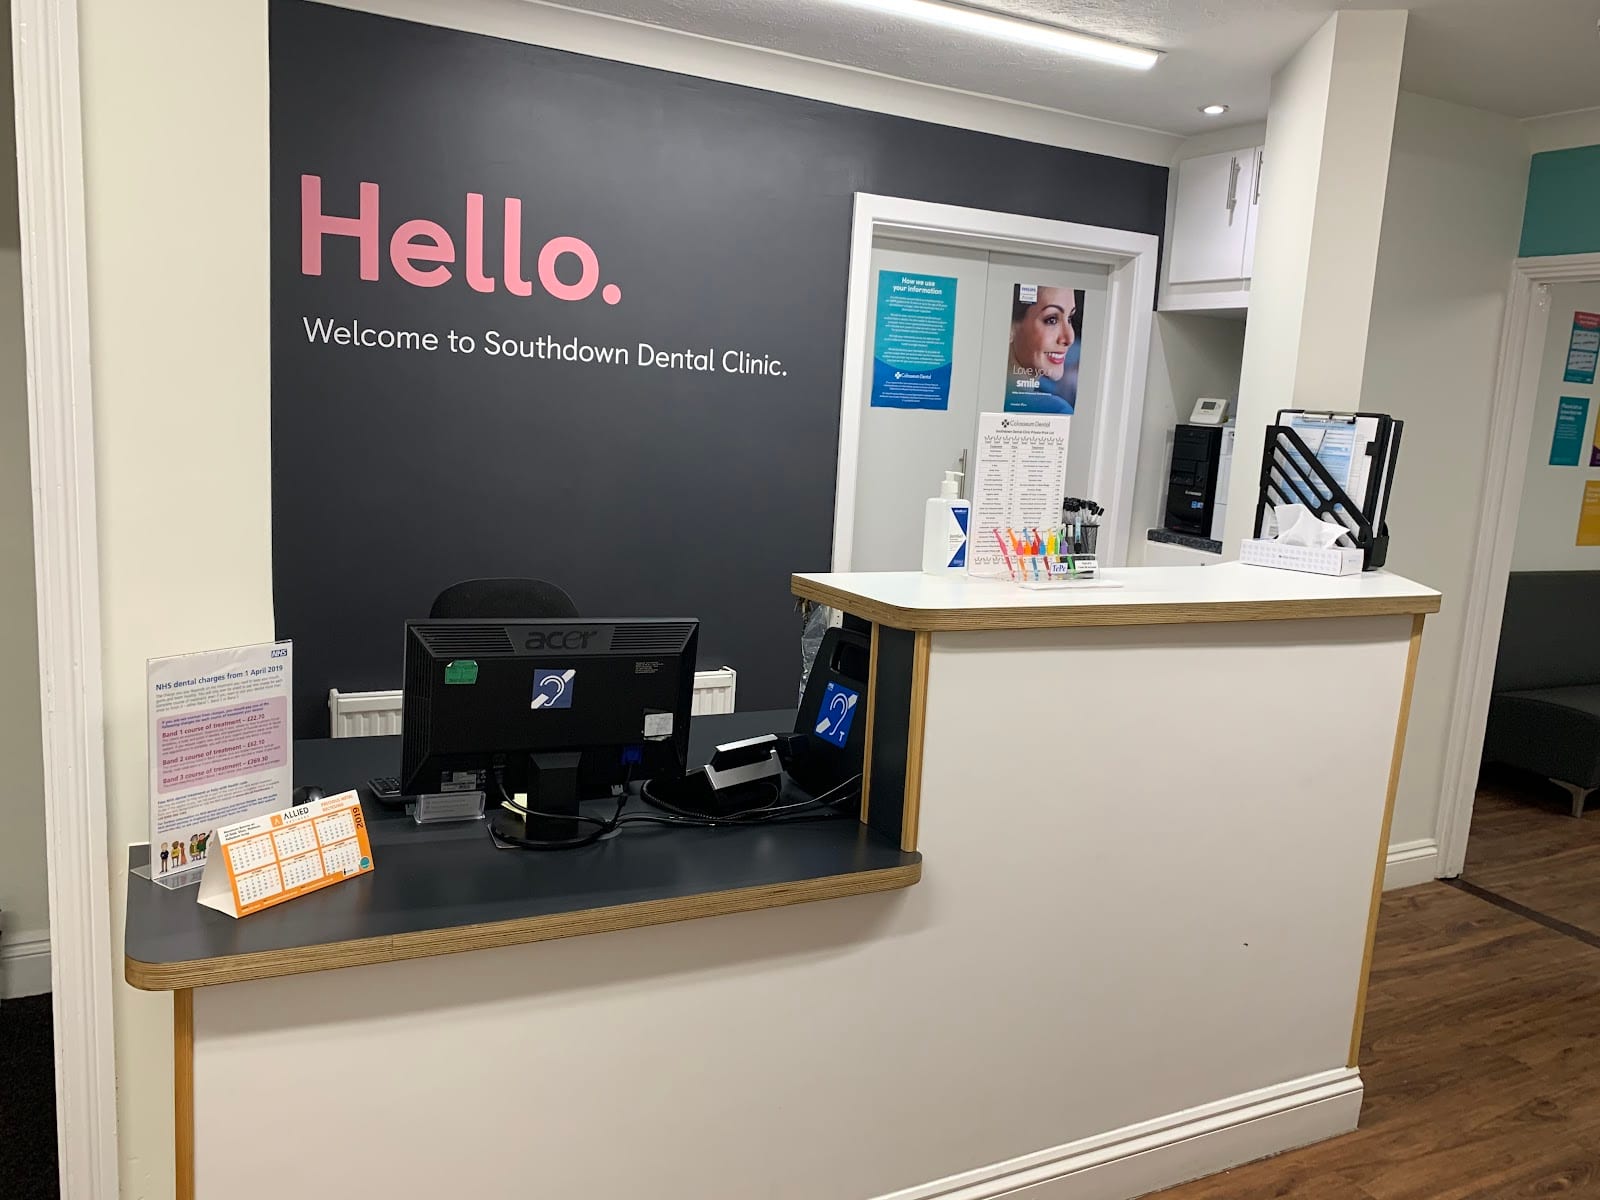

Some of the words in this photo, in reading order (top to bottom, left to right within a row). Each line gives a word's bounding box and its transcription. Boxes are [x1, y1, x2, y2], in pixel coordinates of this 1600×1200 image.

[301, 174, 621, 305] Hello.
[893, 285, 907, 293] your
[908, 286, 942, 295] information
[901, 277, 915, 285] How
[302, 316, 439, 351] Welcome
[448, 330, 476, 353] to
[484, 331, 629, 365] Southdown
[637, 343, 715, 372] Dental
[721, 350, 788, 377] Clinic.
[1013, 364, 1033, 376] Love
[1035, 367, 1050, 378] you
[1016, 379, 1040, 389] smile
[1052, 564, 1066, 573] TePe
[525, 631, 598, 650] acer
[272, 649, 287, 658] NHS
[155, 683, 172, 691] NHS
[173, 678, 197, 688] dental
[198, 675, 226, 685] charges
[227, 672, 243, 680] from
[250, 666, 267, 677] April
[267, 665, 283, 673] 2019
[162, 730, 178, 738] Band
[184, 726, 204, 734] course
[213, 718, 242, 729] treatment
[162, 758, 178, 766] Band
[185, 753, 204, 761] course
[213, 744, 242, 755] treatment
[163, 776, 179, 784] Band
[185, 771, 204, 779] course
[213, 762, 242, 773] treatment
[283, 806, 309, 820] ALLIED
[352, 807, 363, 829] 2019
